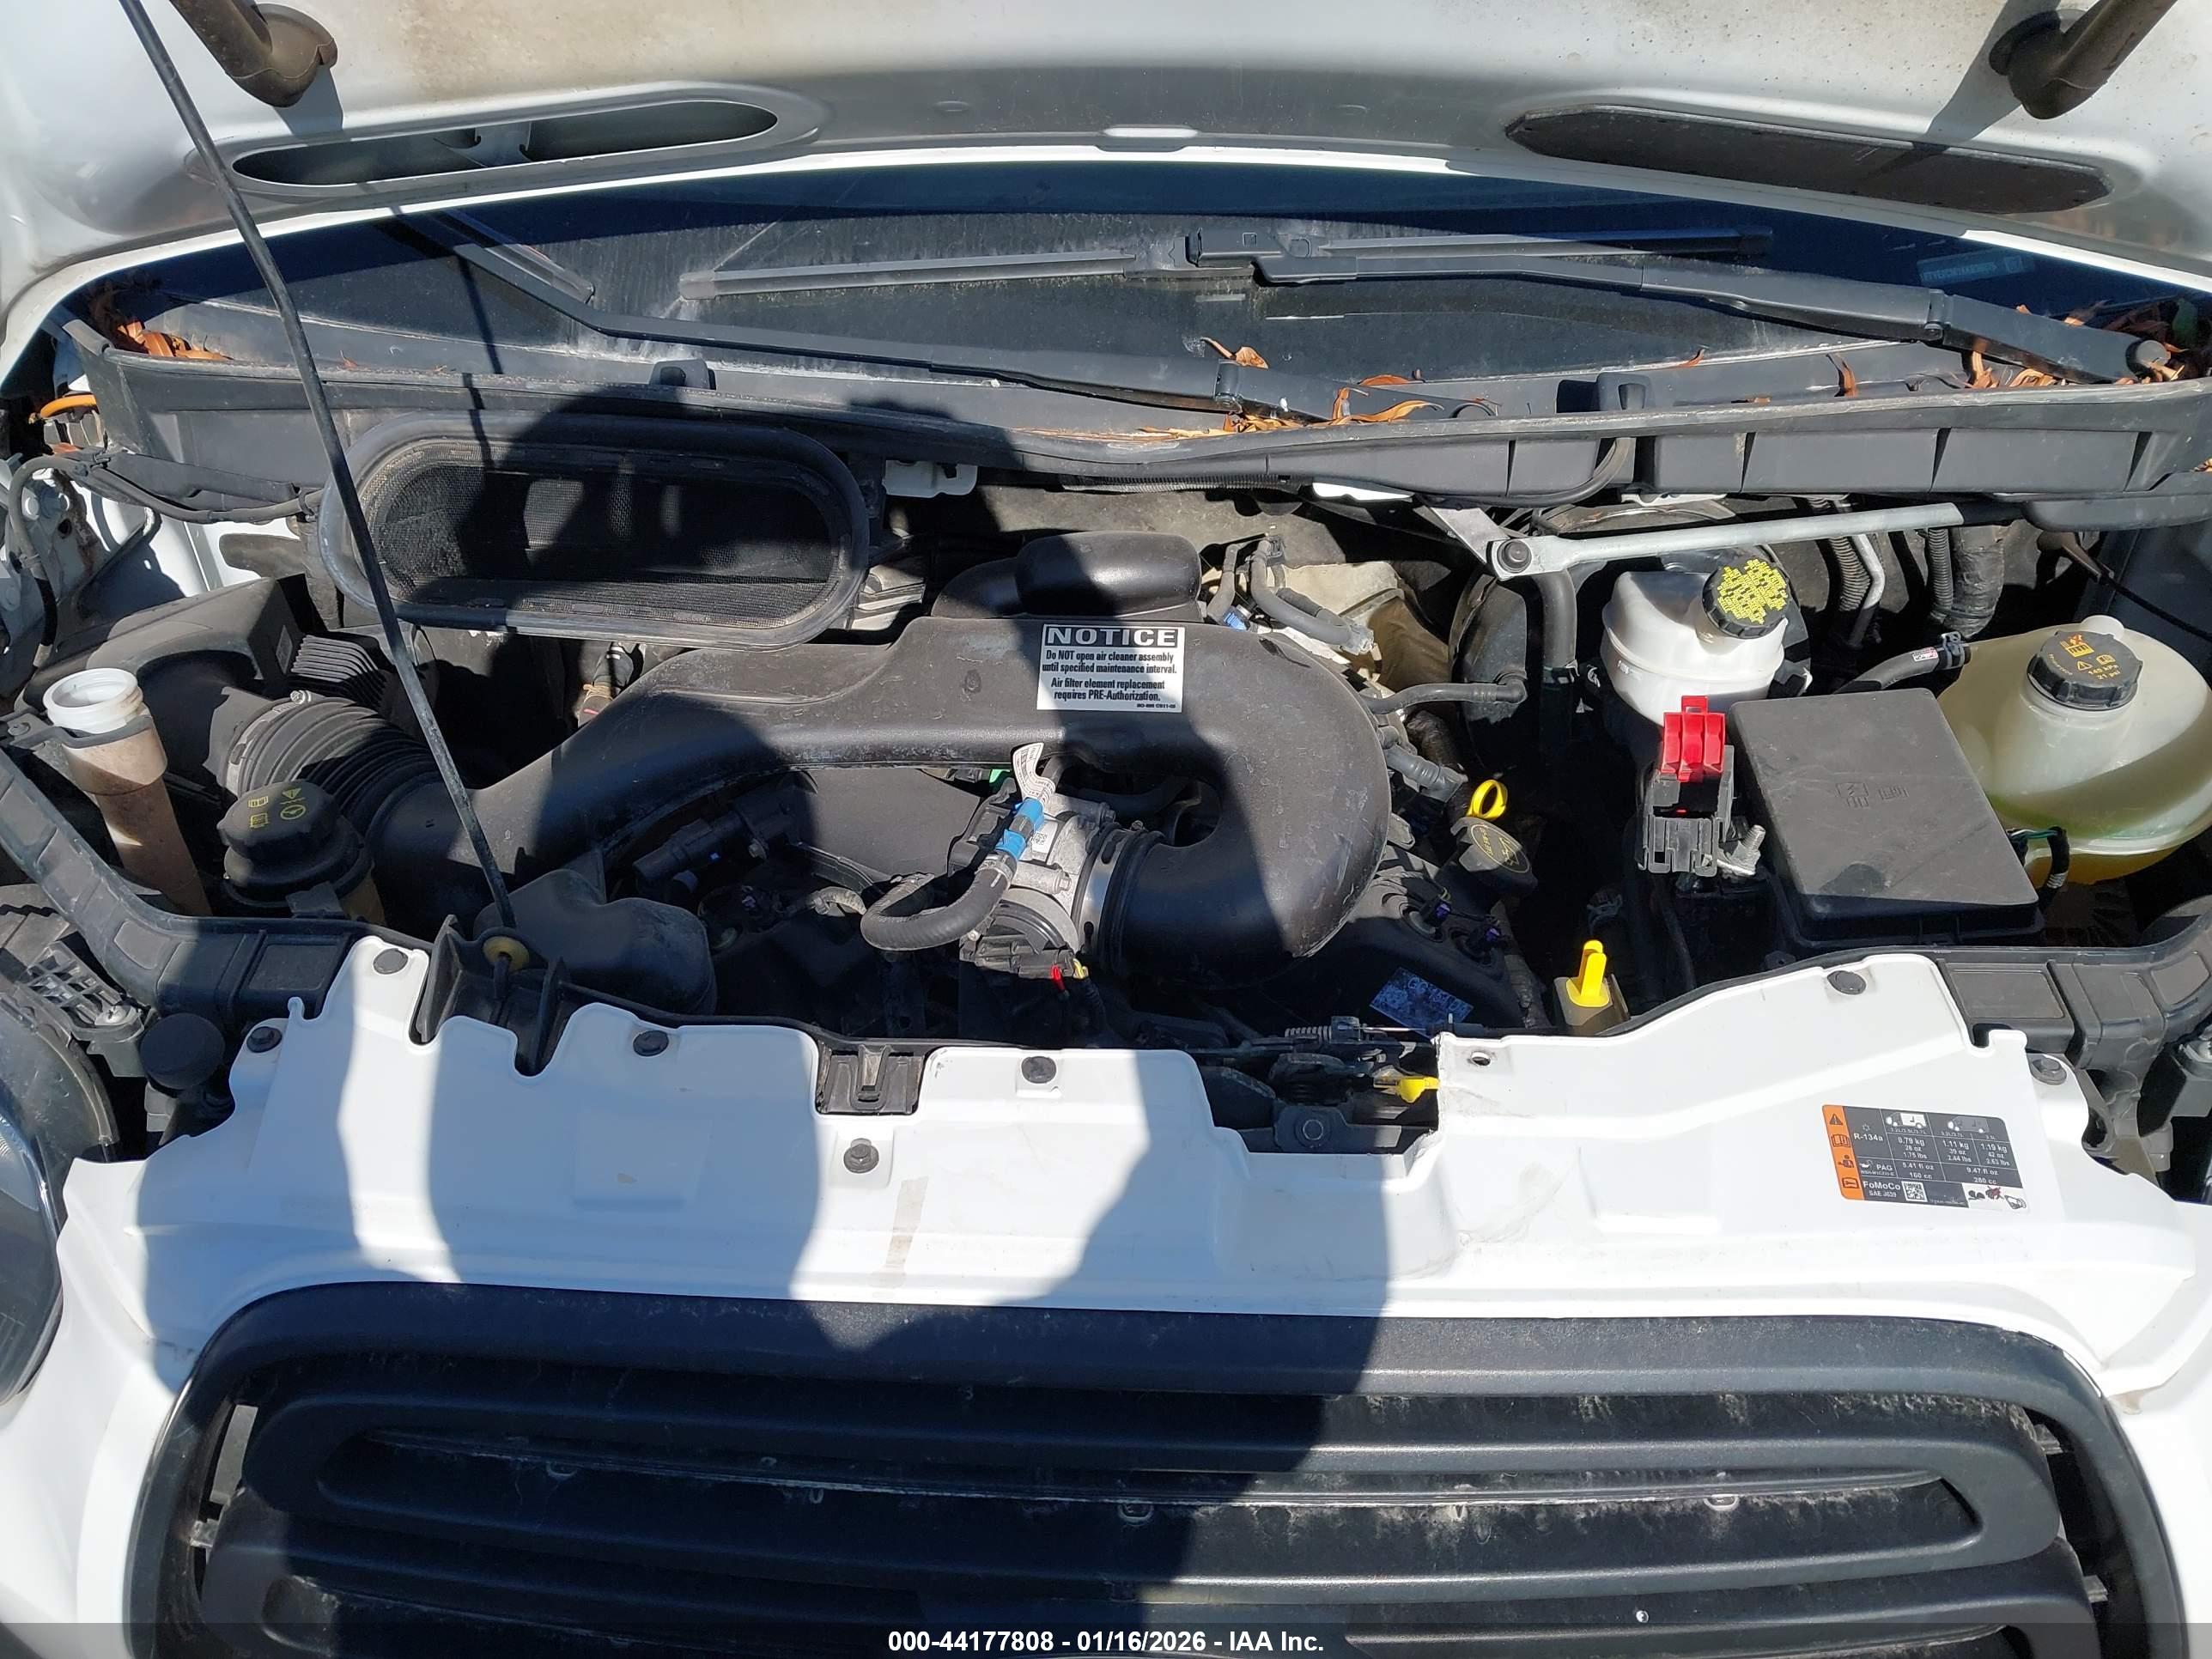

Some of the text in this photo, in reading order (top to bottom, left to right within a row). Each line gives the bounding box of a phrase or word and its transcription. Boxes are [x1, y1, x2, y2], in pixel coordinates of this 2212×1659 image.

[1047, 628, 1176, 646] NOTICE
[1046, 650, 1174, 664] Do NOT open air cleaner assembly
[1042, 662, 1177, 674] until specified maintenance interval.
[1051, 678, 1165, 691] Air filter element replacement
[1054, 690, 1161, 702] requires PRE-Authorization.
[1914, 1138, 1925, 1147] kg
[1959, 1141, 1969, 1150] kg
[1997, 1145, 2008, 1153] kg
[1863, 1181, 1900, 1190] FoMoCo
